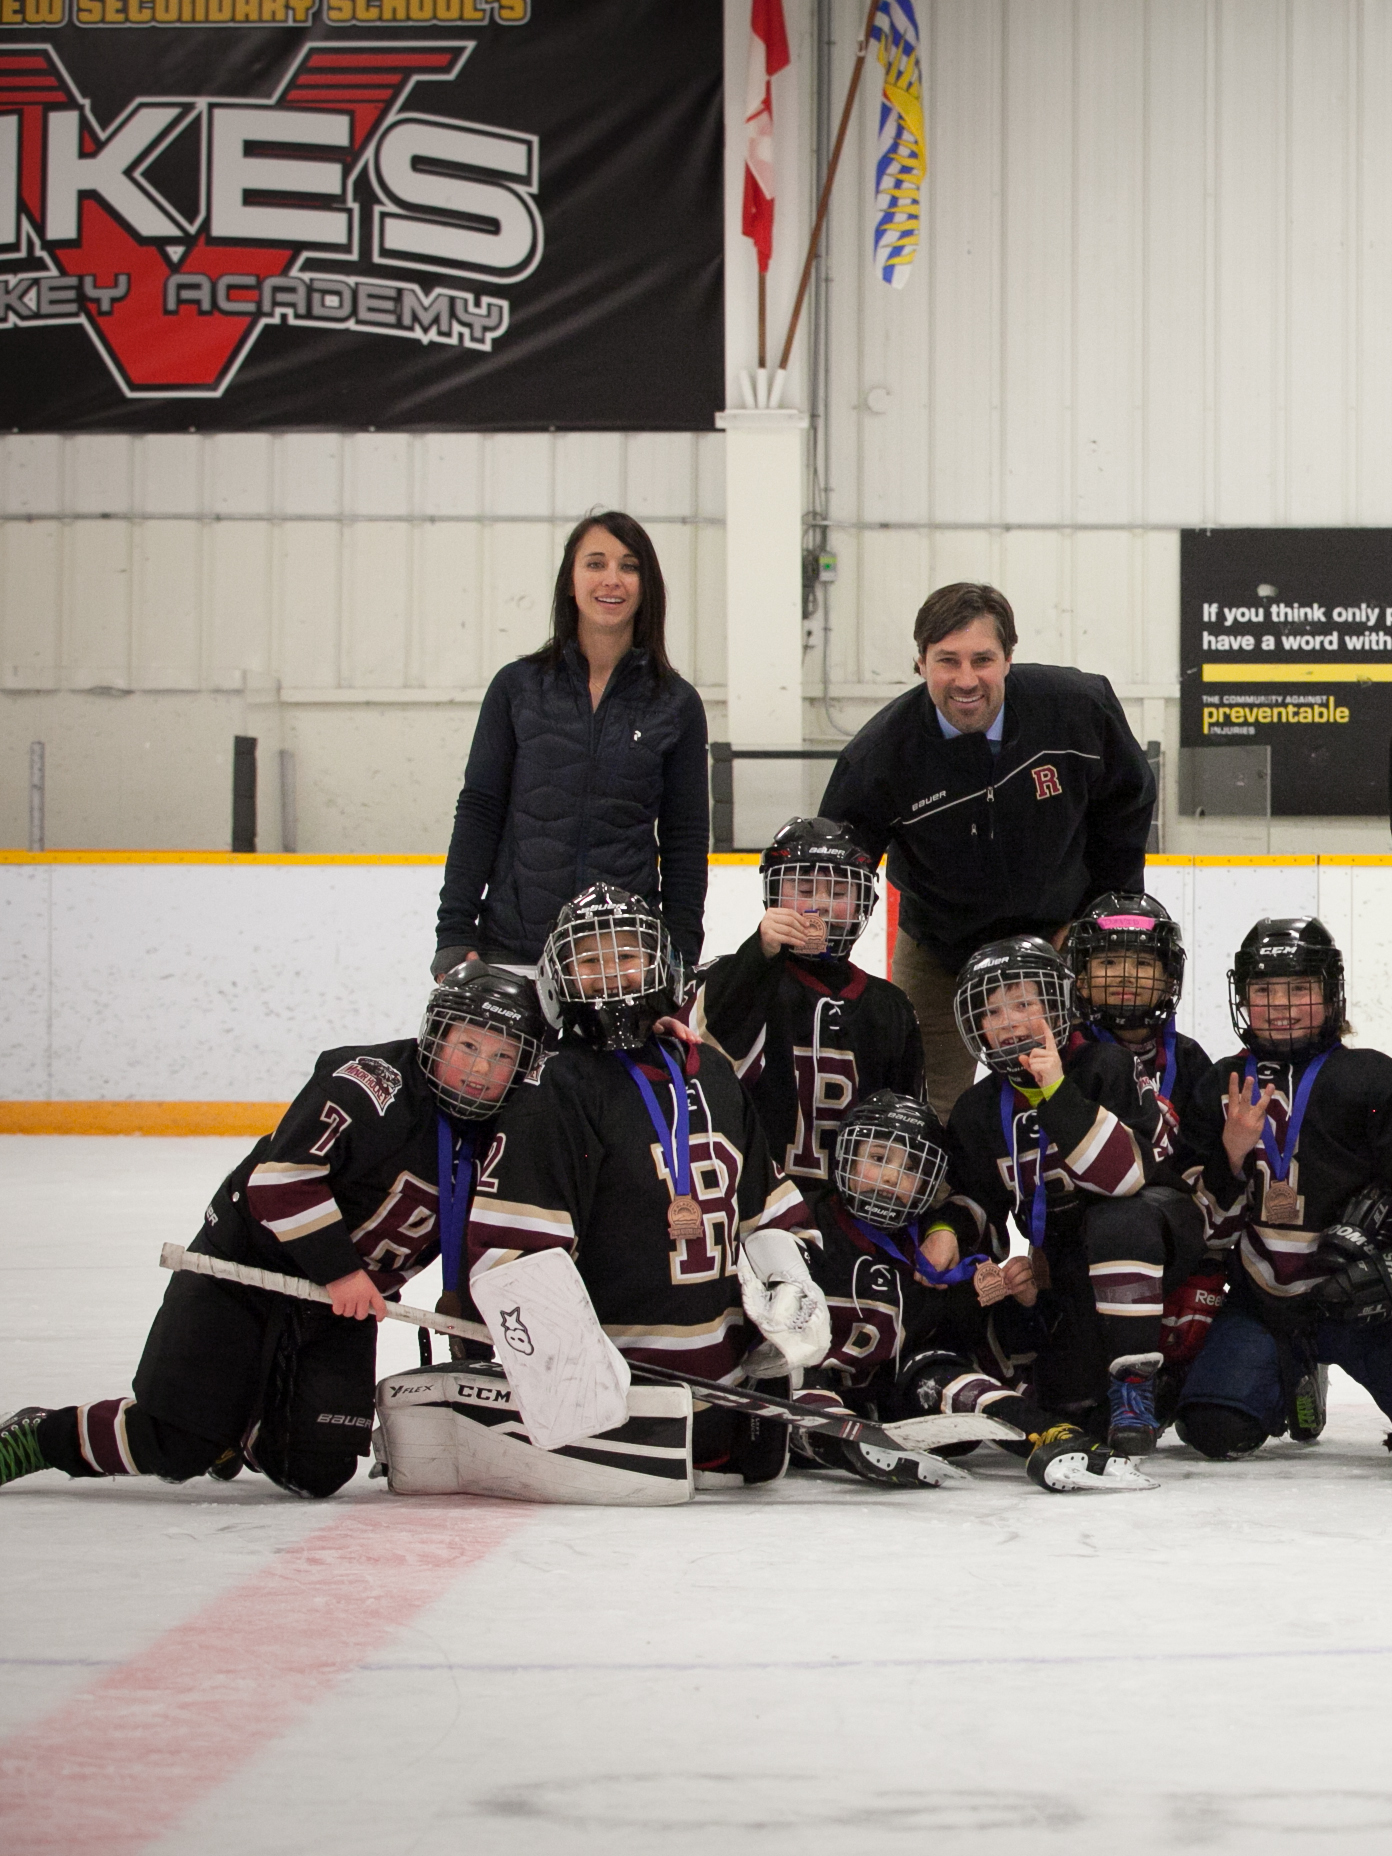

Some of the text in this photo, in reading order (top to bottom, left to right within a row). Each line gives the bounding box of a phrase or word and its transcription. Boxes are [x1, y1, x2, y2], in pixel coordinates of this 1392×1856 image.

[165, 273, 504, 339] ACADEMY
[1202, 603, 1219, 622] If
[1223, 607, 1264, 626] you
[1270, 603, 1327, 622] think
[1331, 603, 1380, 626] only
[1202, 631, 1255, 650] have
[1261, 635, 1275, 650] a
[1281, 631, 1338, 650] word
[1344, 631, 1392, 650] with
[1202, 695, 1328, 704] THE COMMUNITY AGAINST
[1202, 696, 1350, 734] preventable
[1210, 726, 1256, 735] INJURIES
[1031, 764, 1063, 800] R
[310, 1100, 352, 1157] 7
[887, 1111, 926, 1127] BAUER
[650, 1131, 741, 1285] R
[456, 1383, 513, 1403] CCM
[316, 1412, 373, 1429] BAUER
